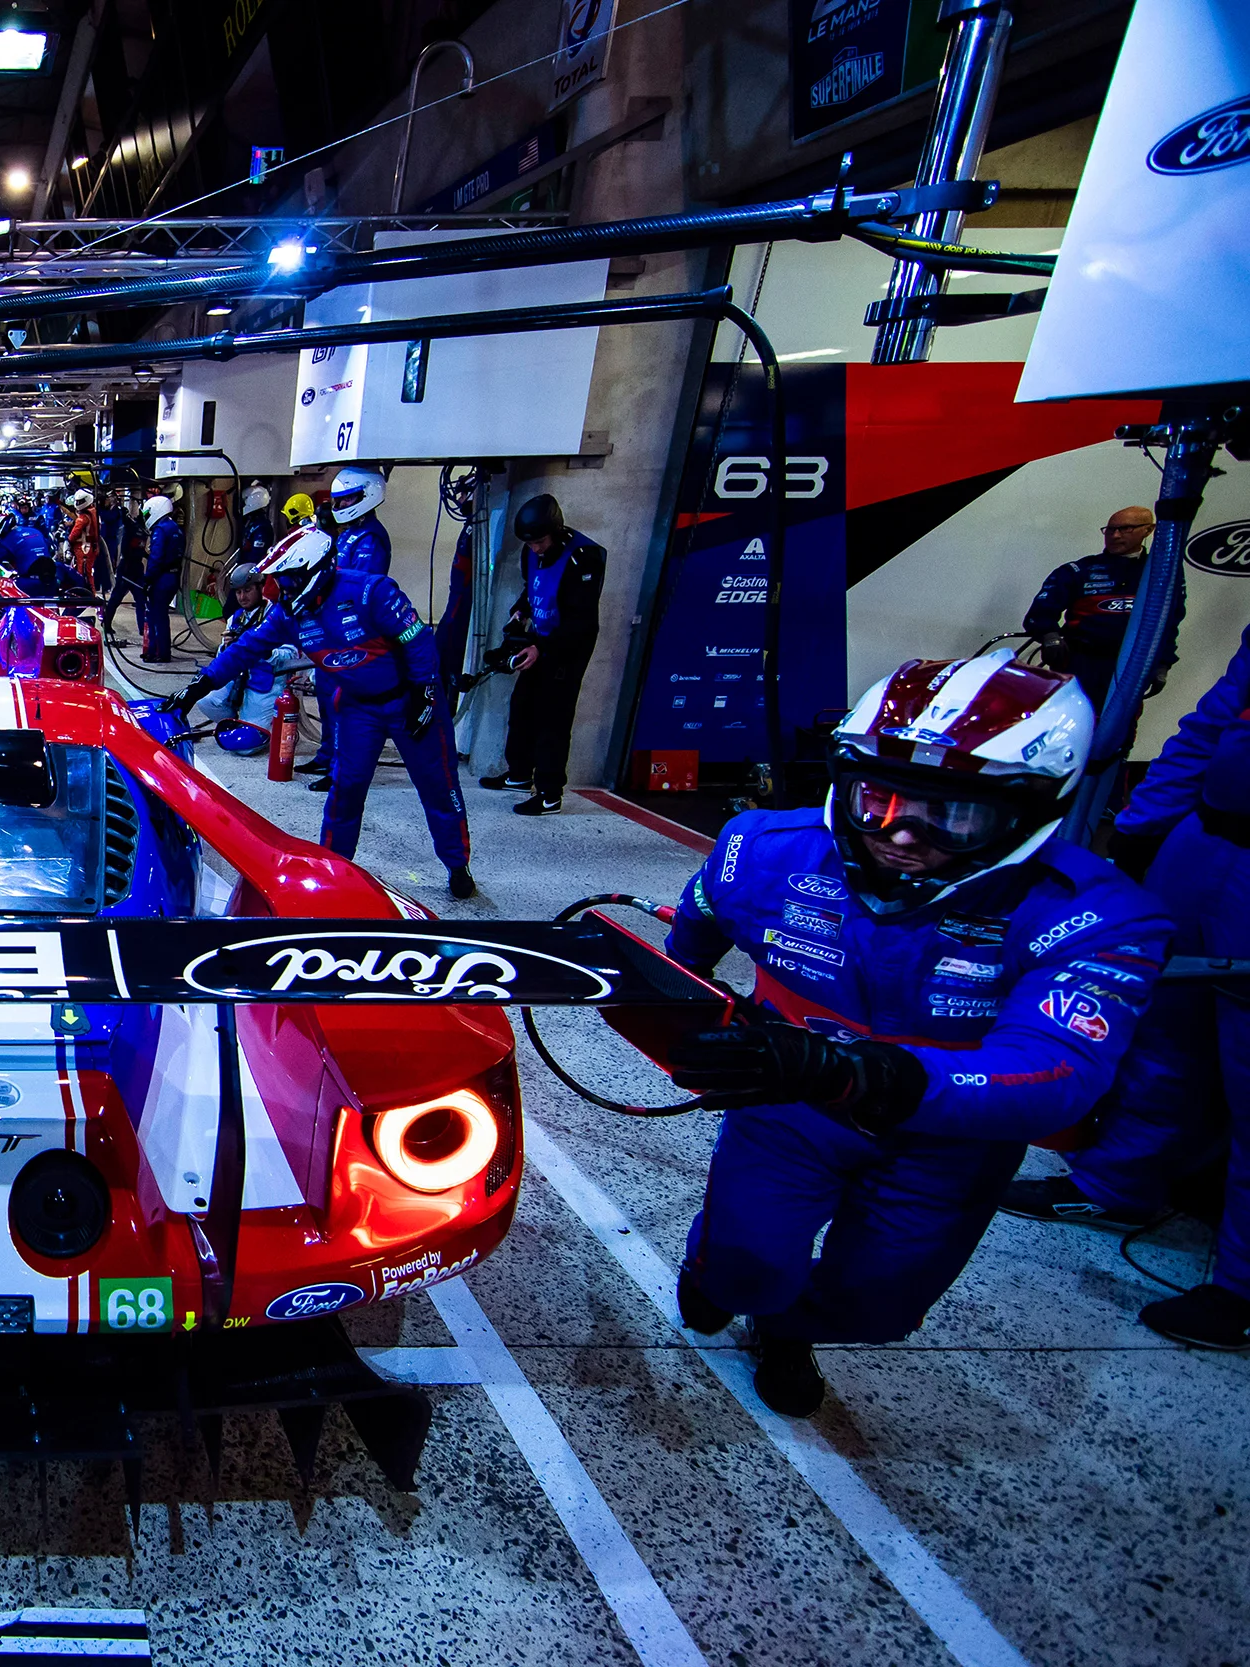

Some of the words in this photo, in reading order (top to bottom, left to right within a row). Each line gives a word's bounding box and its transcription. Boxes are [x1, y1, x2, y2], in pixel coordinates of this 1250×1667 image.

[807, 19, 828, 44] LE
[554, 55, 598, 98] TOTAL
[811, 55, 882, 106] SUPERFINALE
[1178, 108, 1250, 166] For
[476, 171, 490, 196] PRO
[337, 421, 354, 451] 67
[715, 591, 767, 604] EDGE
[399, 619, 425, 643] PITLANE
[332, 653, 359, 666] Ford
[797, 875, 842, 898] Ford
[784, 940, 838, 960] MICHELIN
[931, 1008, 999, 1018] EDGE
[1050, 990, 1101, 1024] VP
[379, 1248, 479, 1301] EcoBoost
[382, 1258, 428, 1282] Powered
[428, 1251, 442, 1267] by
[107, 1288, 166, 1330] 68
[284, 1289, 346, 1317] Ford
[223, 1316, 251, 1329] OW
